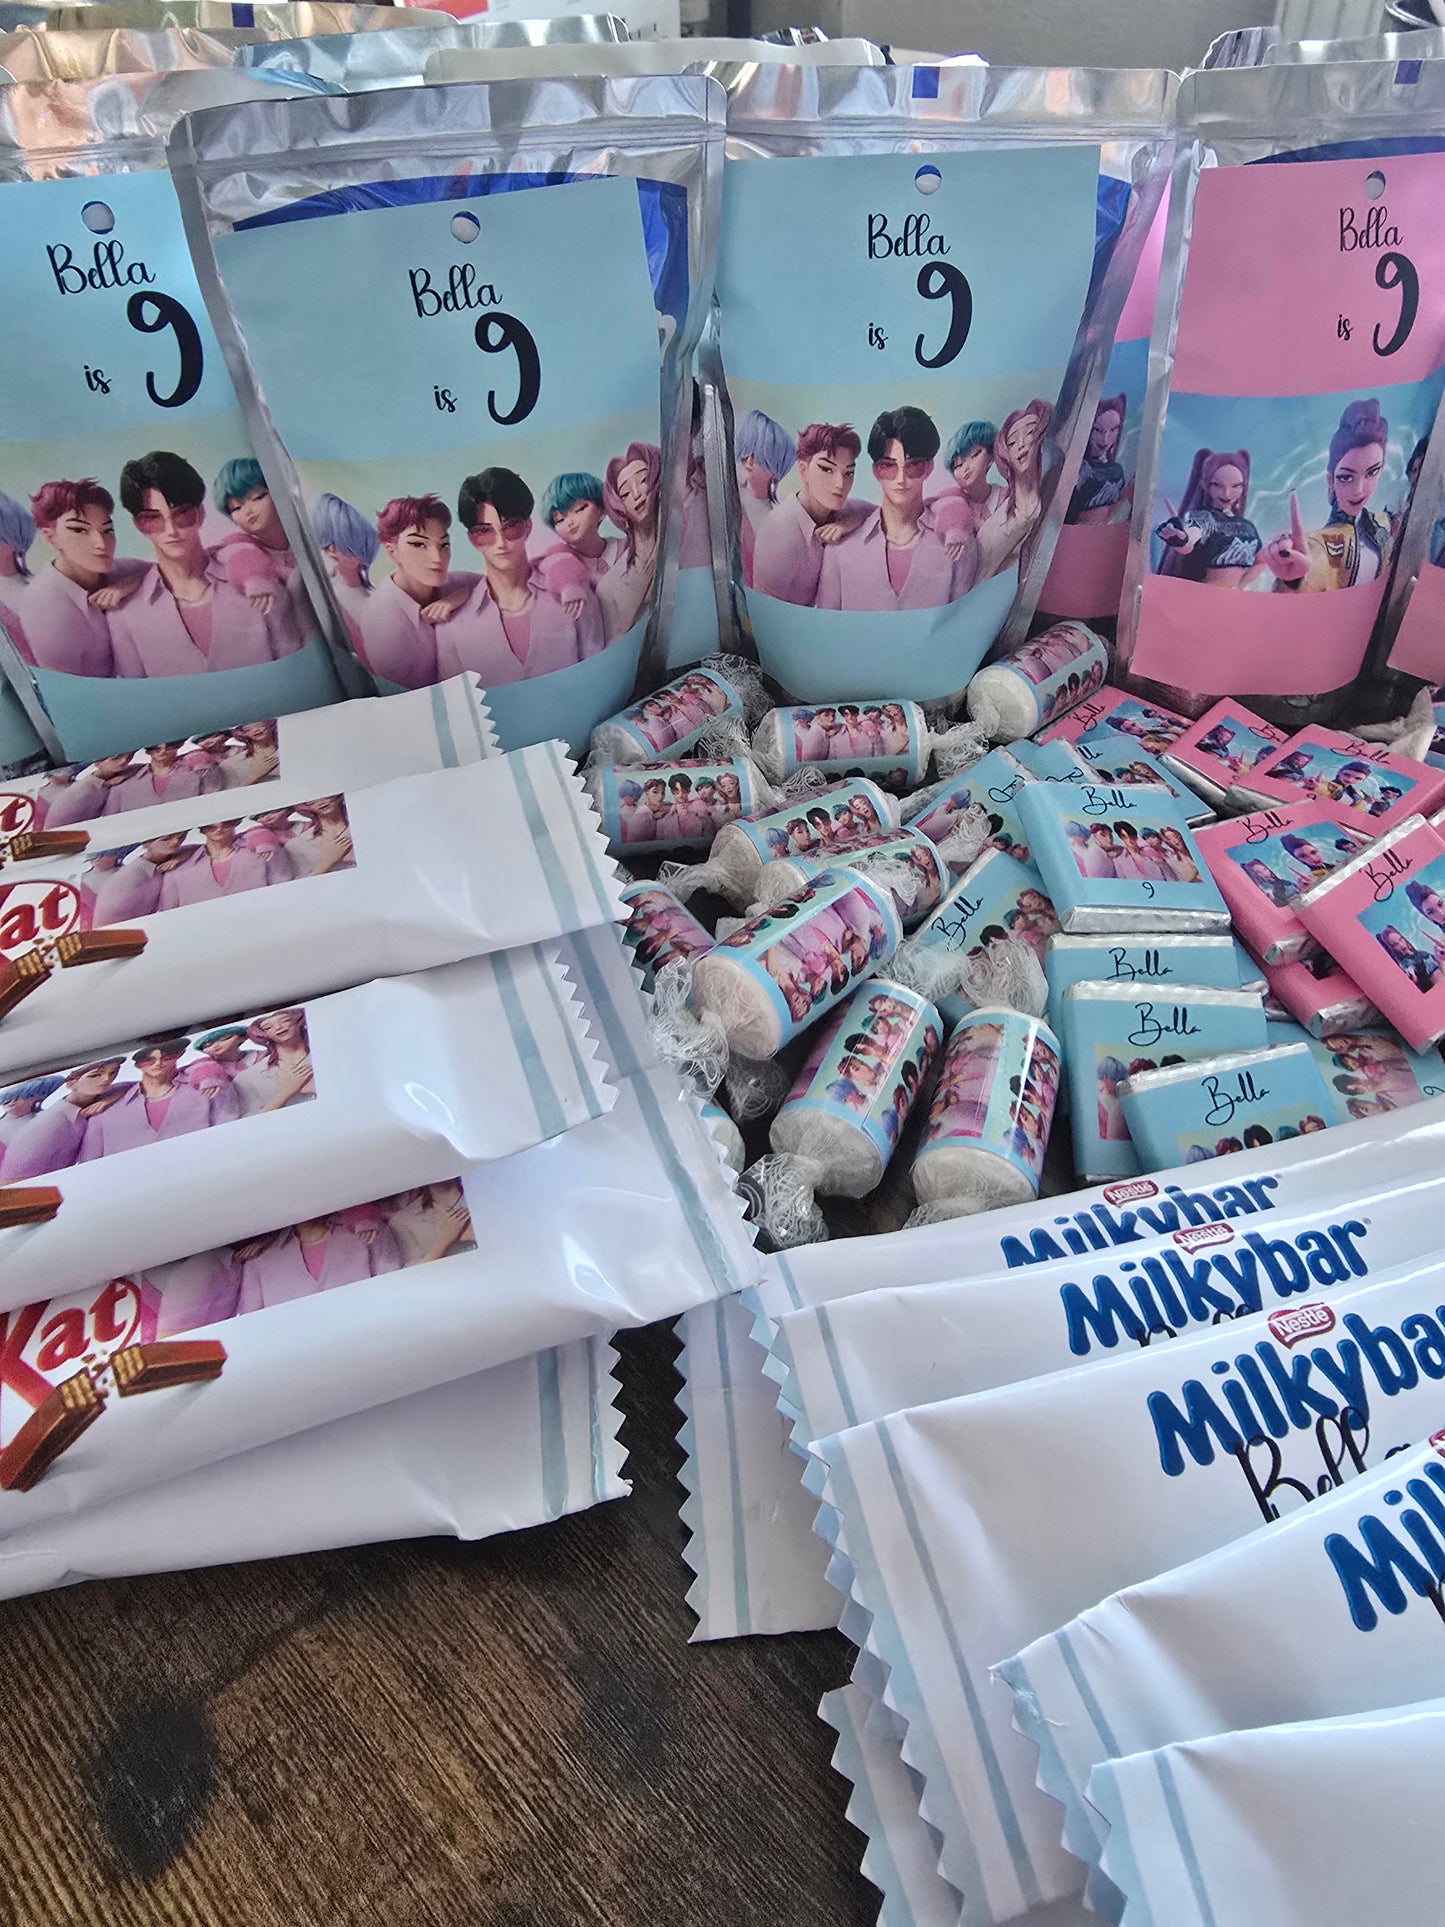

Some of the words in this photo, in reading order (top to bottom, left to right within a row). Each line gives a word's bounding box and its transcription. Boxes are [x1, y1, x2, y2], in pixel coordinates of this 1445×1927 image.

[867, 213, 951, 259] Bella
[1340, 206, 1403, 252] Bella
[46, 240, 156, 295] Bella
[408, 263, 503, 318] Bella
[867, 321, 889, 351] is
[914, 261, 973, 369] 9
[1337, 313, 1354, 341] is
[1373, 252, 1420, 357] 9
[83, 364, 112, 395] is
[126, 291, 204, 408] 9
[433, 384, 458, 413] is
[475, 312, 541, 425] 9
[1081, 786, 1137, 815] Bella
[1236, 810, 1294, 844] Bella
[1359, 848, 1414, 902] Bella
[931, 895, 984, 952] Bella
[1106, 947, 1173, 981] Bella
[1127, 1001, 1202, 1047] Bella
[1201, 1070, 1270, 1126] Bella
[1060, 1219, 1368, 1356] Milkybar
[1146, 1304, 1445, 1477] Milkyba
